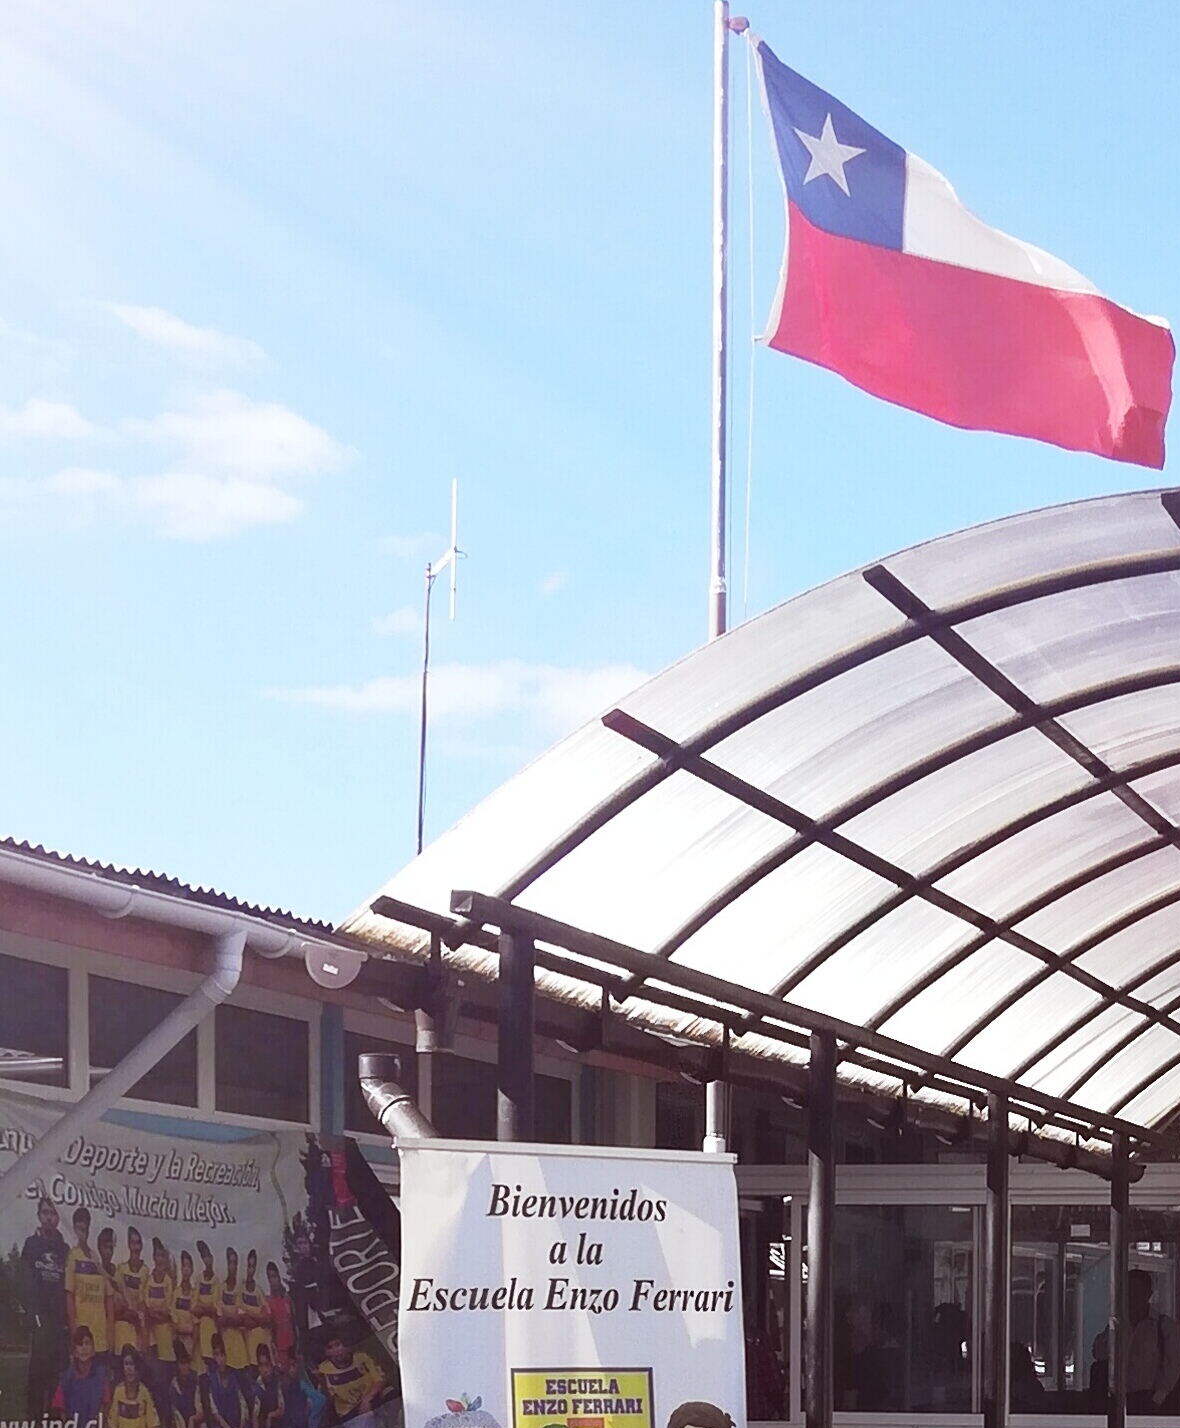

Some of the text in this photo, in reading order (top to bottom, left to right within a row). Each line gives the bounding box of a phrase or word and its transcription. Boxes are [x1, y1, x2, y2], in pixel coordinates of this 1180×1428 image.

[63, 1136, 148, 1176] Deporte
[148, 1152, 167, 1183] y
[165, 1149, 183, 1180] la
[122, 1184, 180, 1222] Mucho
[485, 1183, 668, 1223] Bienvenidos
[548, 1233, 604, 1266] a la
[328, 1205, 400, 1354] EPORTE
[406, 1277, 736, 1314] Escuela Enzo Ferrari
[545, 1379, 620, 1395] ESCUELA
[522, 1398, 644, 1416] ENZO FERRARI
